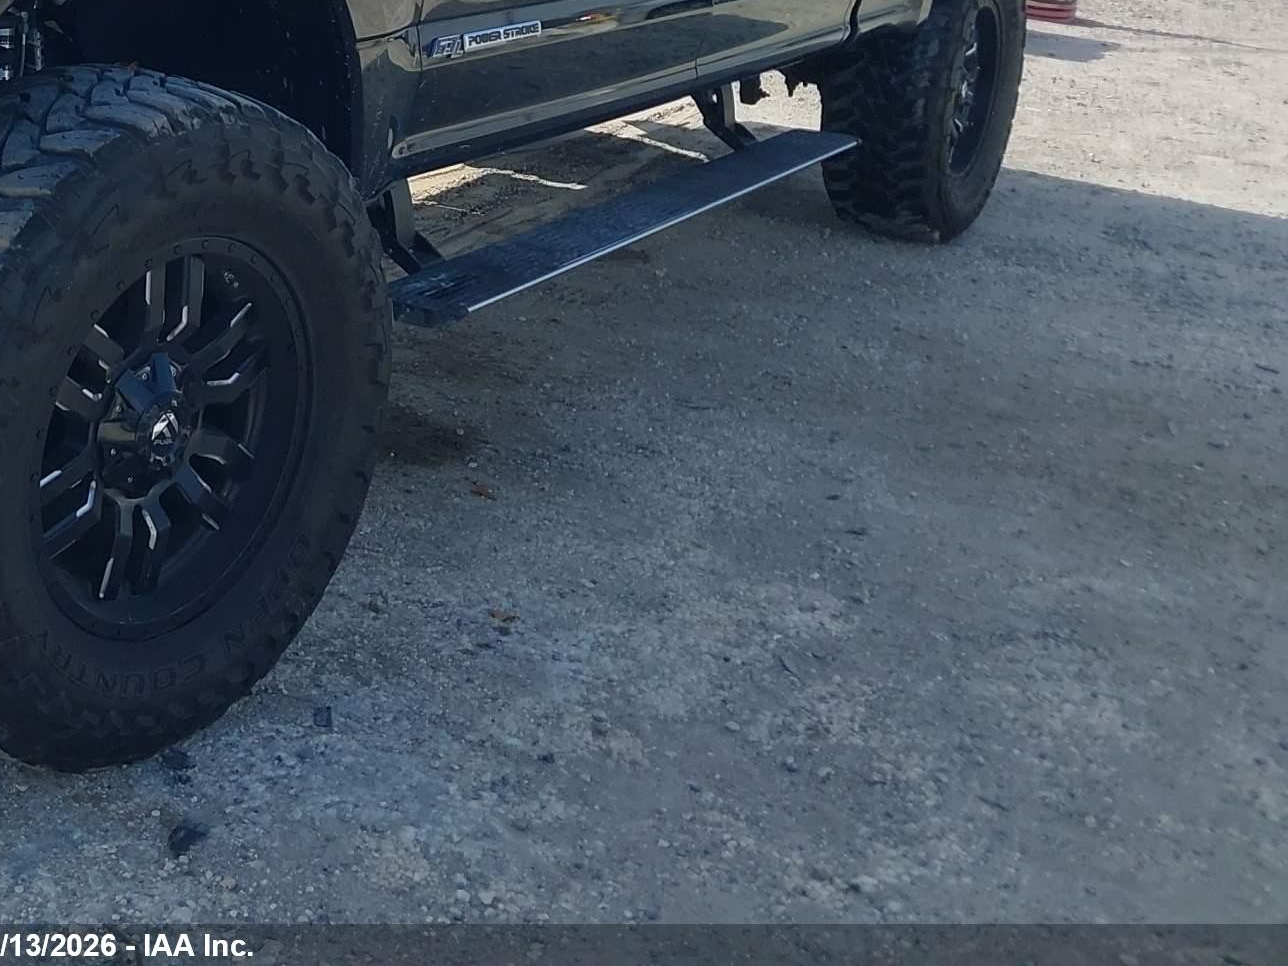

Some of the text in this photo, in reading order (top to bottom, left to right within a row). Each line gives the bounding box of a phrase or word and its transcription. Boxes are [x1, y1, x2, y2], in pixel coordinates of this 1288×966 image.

[468, 31, 502, 46] POWER
[503, 23, 540, 39] STROKE
[41, 628, 209, 700] COUNTRY
